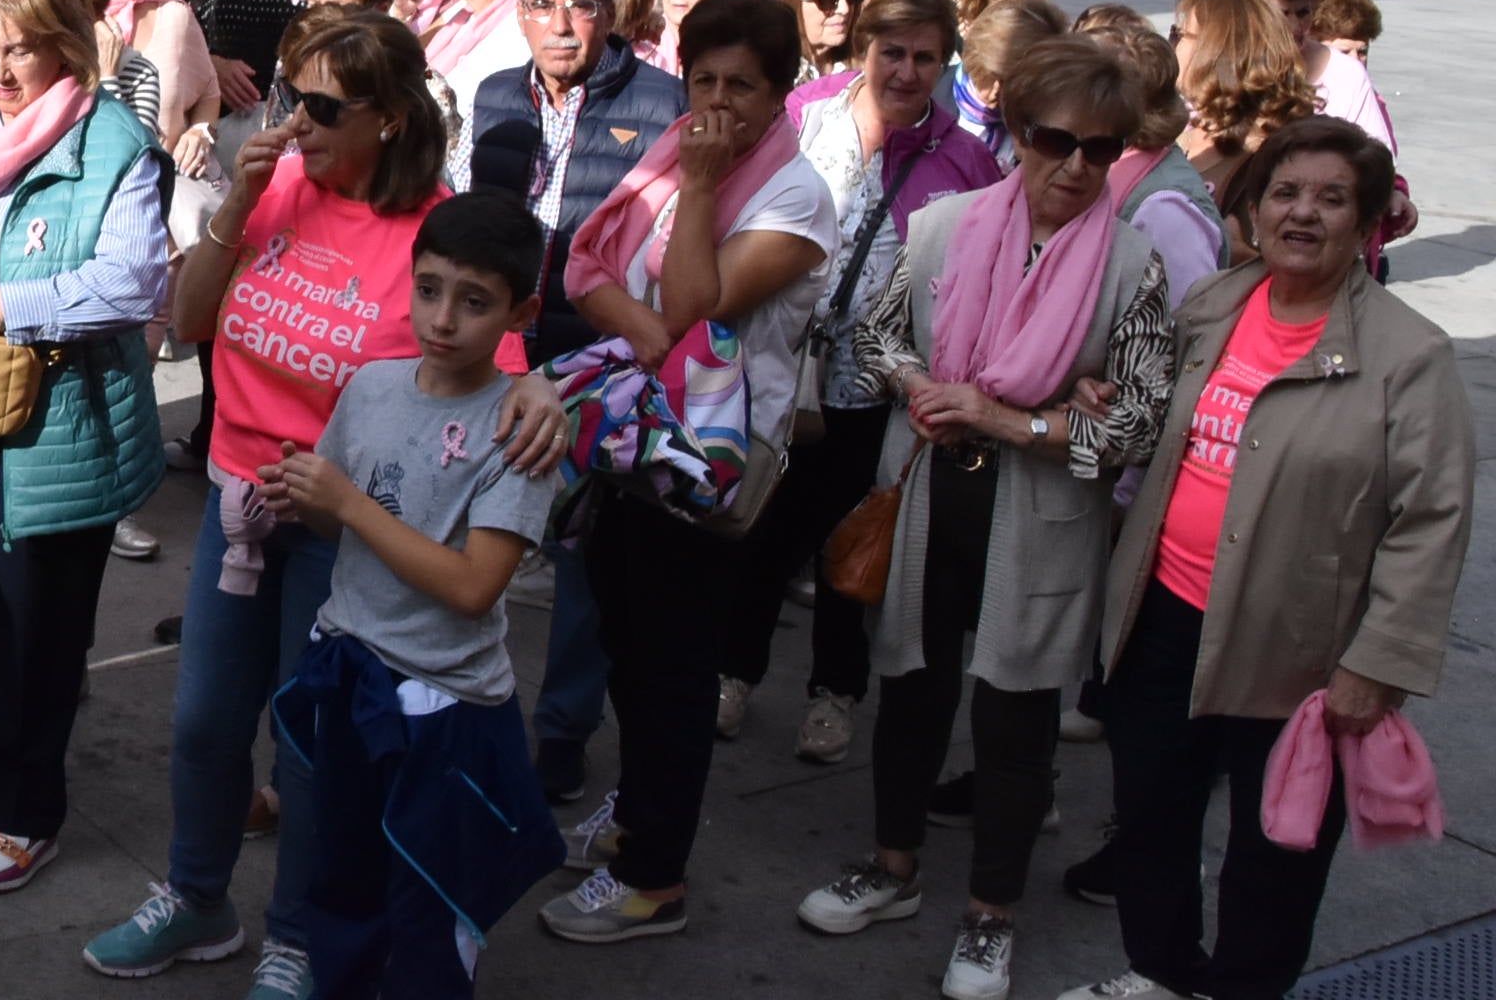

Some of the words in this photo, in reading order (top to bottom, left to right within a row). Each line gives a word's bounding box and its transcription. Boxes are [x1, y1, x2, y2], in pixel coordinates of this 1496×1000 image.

[224, 313, 359, 388] cáncer
[234, 282, 330, 339] contra
[330, 325, 367, 354] el
